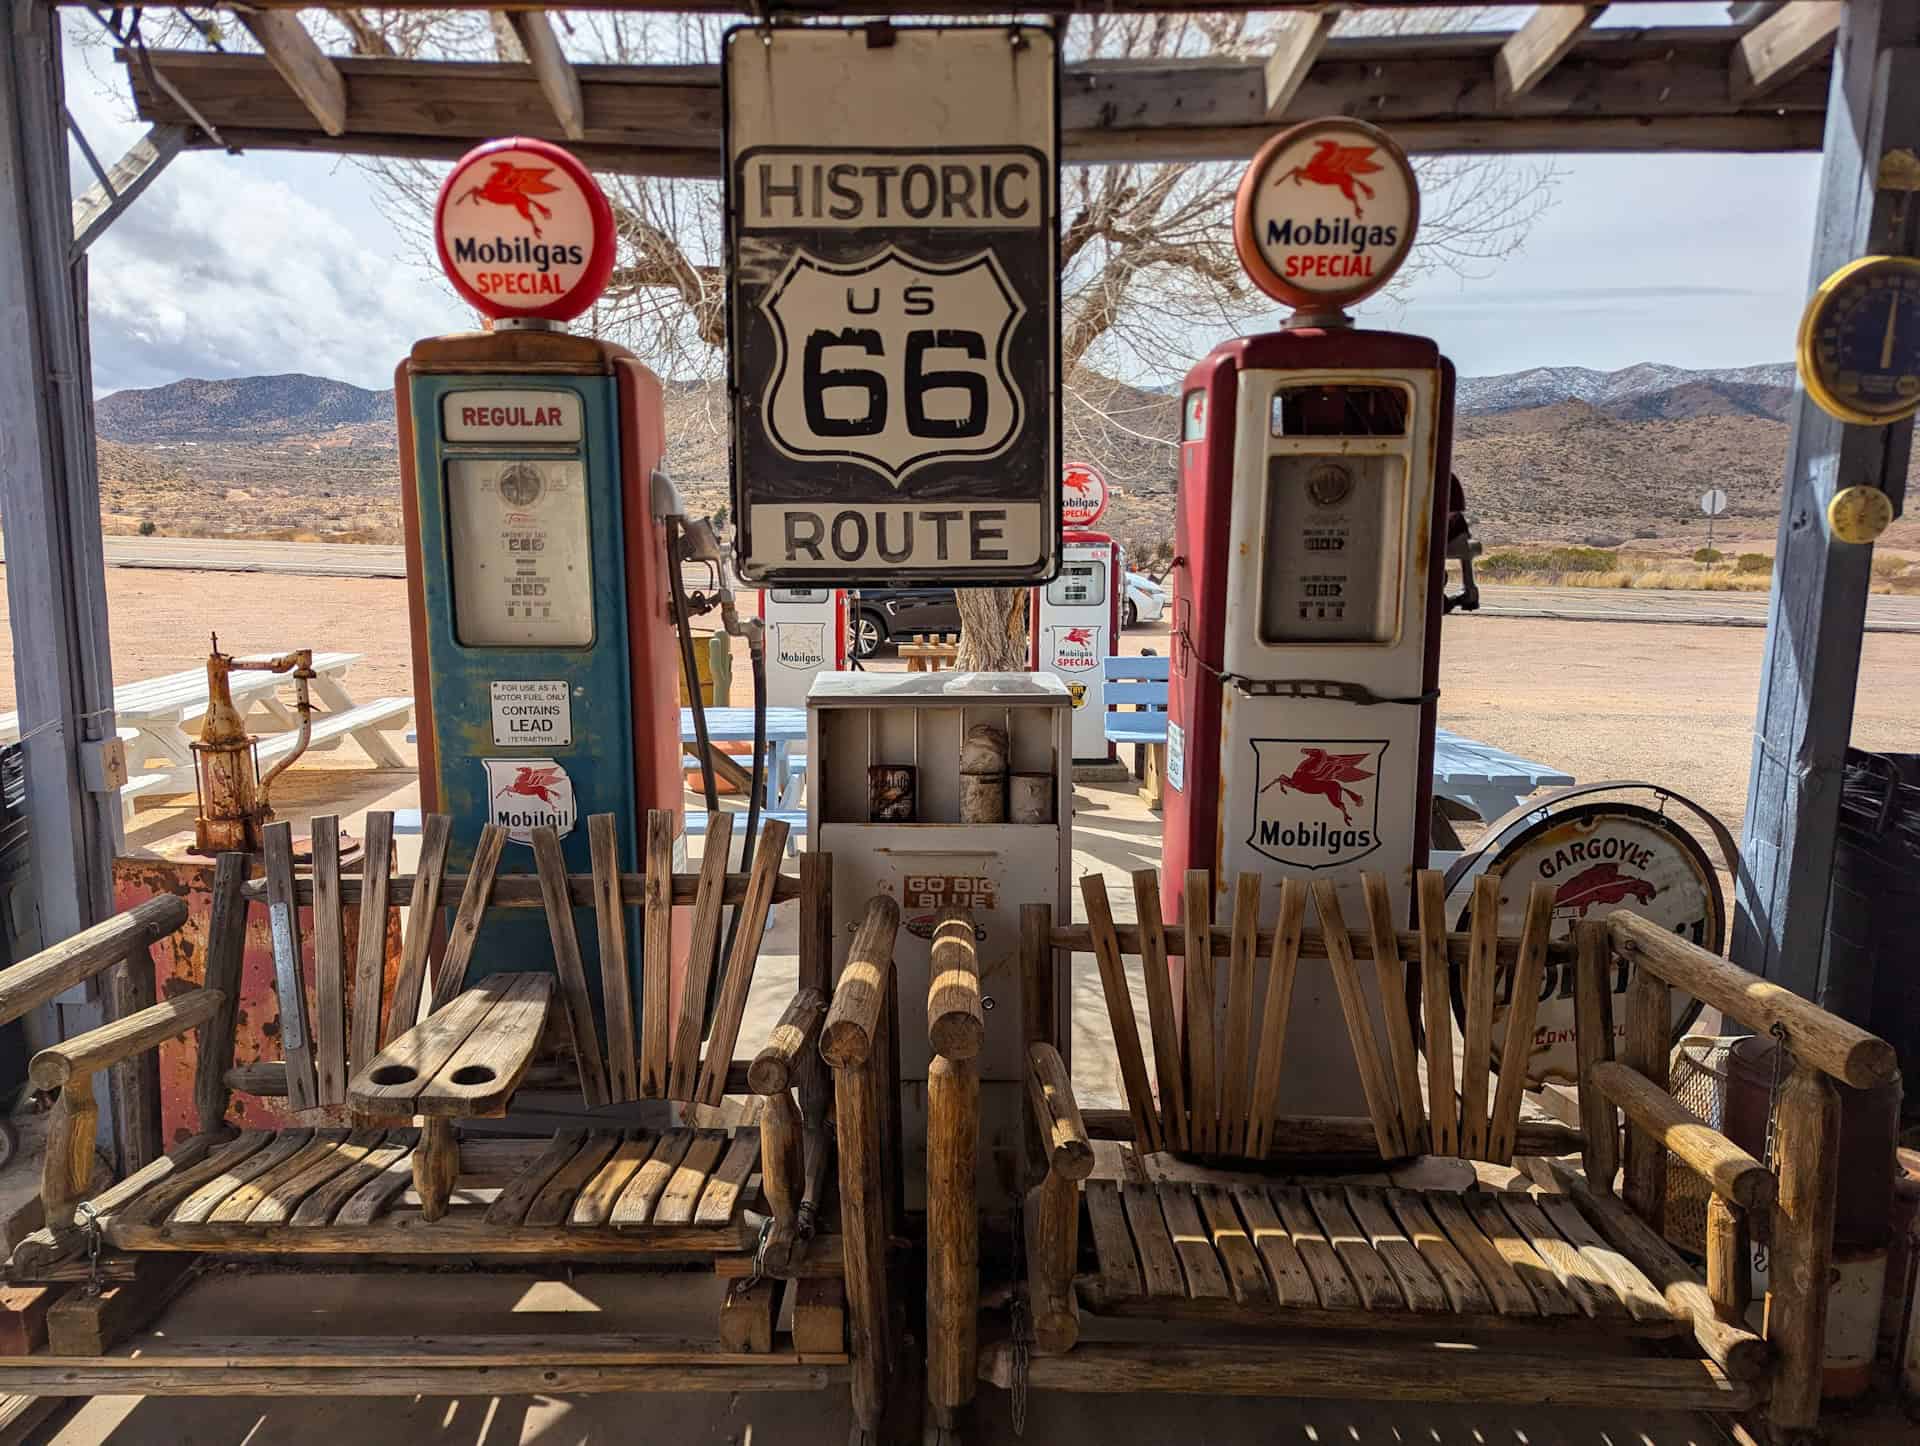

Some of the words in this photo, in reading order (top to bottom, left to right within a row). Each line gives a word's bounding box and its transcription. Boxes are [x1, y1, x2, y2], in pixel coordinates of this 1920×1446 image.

[759, 163, 1030, 219] HISTORIC
[1266, 218, 1398, 254] Mobilgas
[454, 236, 583, 272] Mobilgas
[1285, 255, 1375, 277] SPECIAL
[476, 273, 566, 294] SPECIAL
[803, 328, 989, 438] 66
[462, 407, 563, 427] REGULAR
[1062, 498, 1099, 509] obilgas
[784, 510, 1009, 562] ROUTE
[781, 652, 821, 664] Mobilgas
[1057, 658, 1095, 666] SPECIAL
[1059, 649, 1093, 658] Mobilgas
[501, 684, 518, 692] FOR
[519, 684, 536, 692] USE
[502, 705, 560, 716] CONTAINS
[510, 719, 553, 732] LEAD
[498, 811, 568, 827] Mobiloil
[1260, 821, 1370, 854] Mobilgas
[1539, 838, 1656, 878] GARGOYLE
[908, 878, 945, 893] GO
